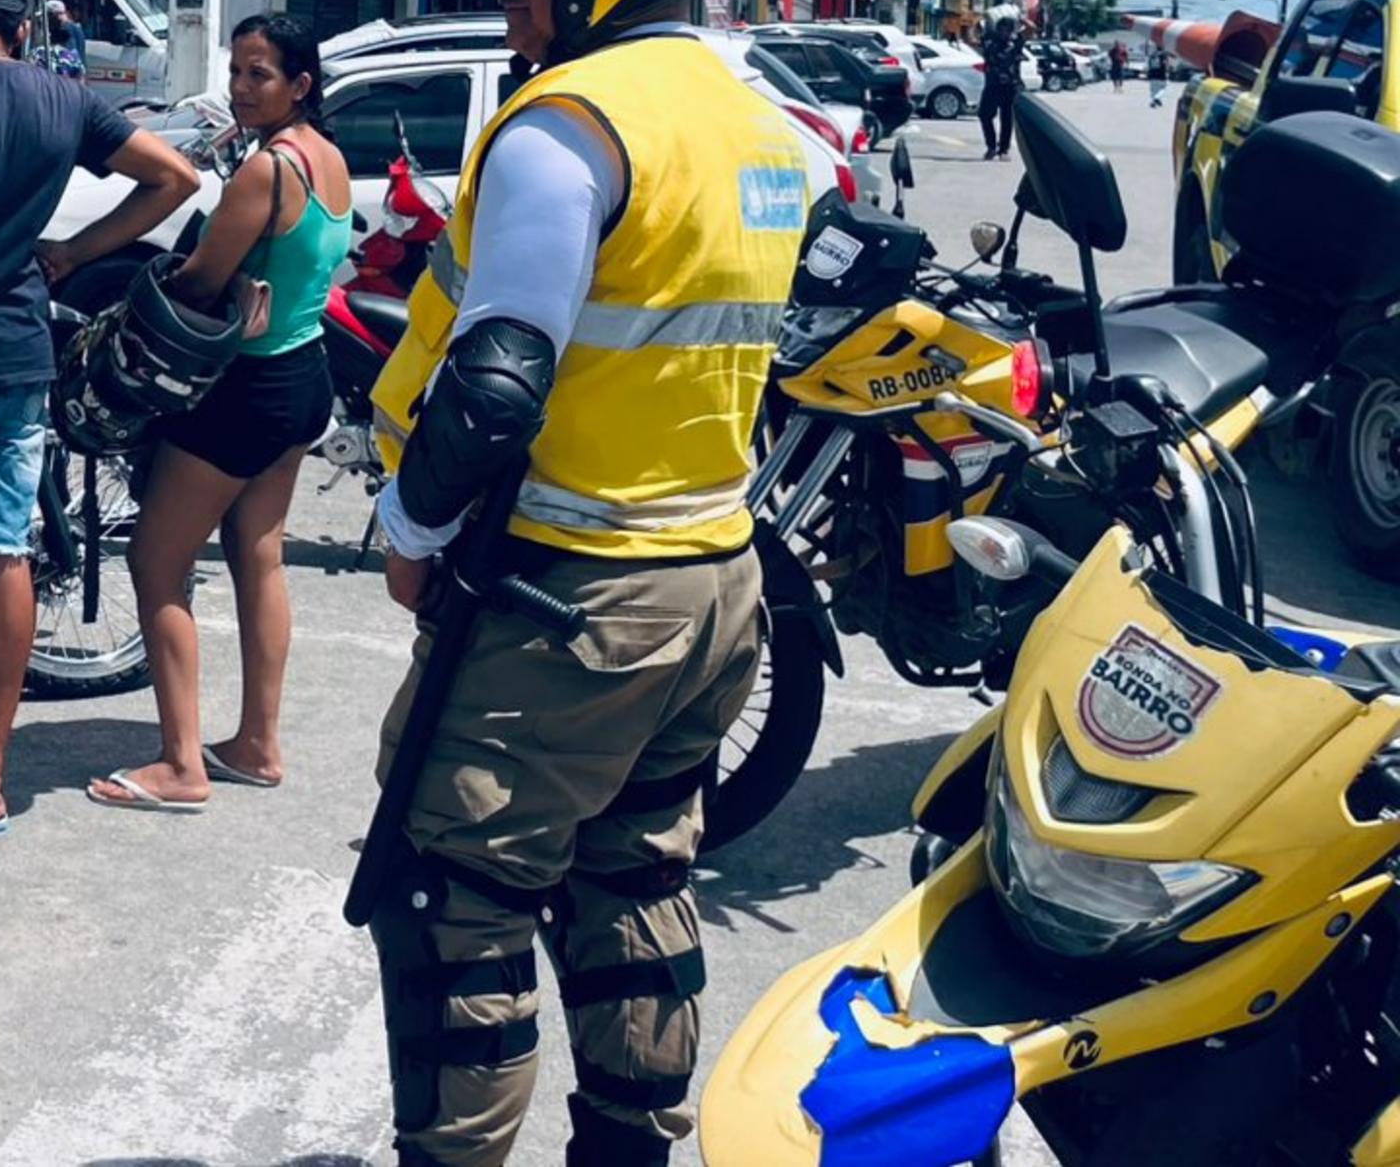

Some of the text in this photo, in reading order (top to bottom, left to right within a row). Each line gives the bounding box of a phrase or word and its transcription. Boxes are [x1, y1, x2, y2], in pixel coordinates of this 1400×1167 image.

[1090, 657, 1193, 735] BAIRRO
[1115, 654, 1162, 693] RONDA
[1165, 689, 1192, 710] NO
